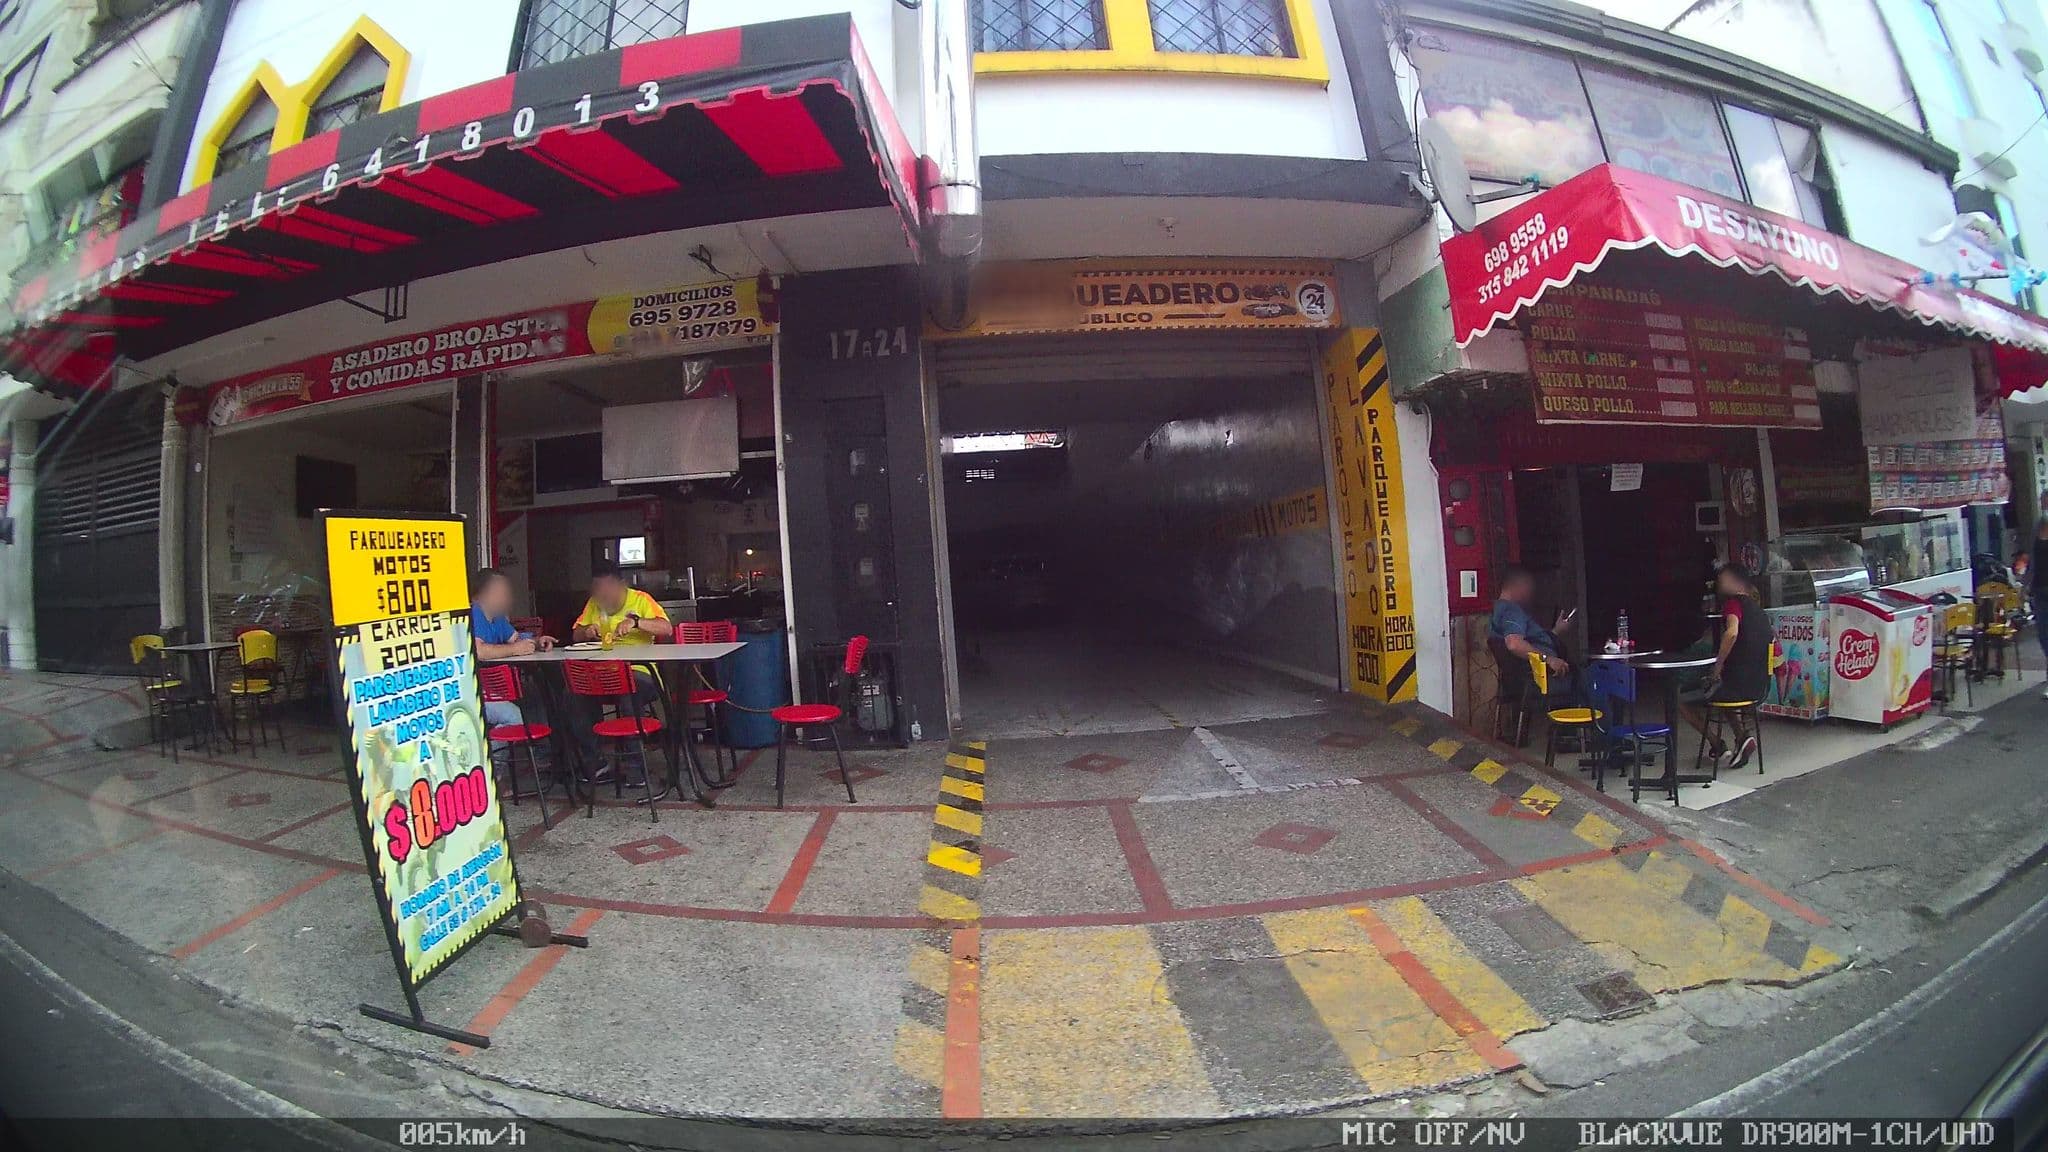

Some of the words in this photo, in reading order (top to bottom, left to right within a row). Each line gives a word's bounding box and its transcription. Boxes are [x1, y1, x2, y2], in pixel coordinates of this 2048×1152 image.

[321, 81, 660, 193] 6418013
[1484, 241, 1509, 273] 698
[1509, 212, 1547, 261] 9558
[1676, 194, 1840, 271] DESAYUNO
[1477, 276, 1502, 304] 315
[1503, 255, 1529, 289] 842
[1530, 225, 1570, 273] 1119
[633, 285, 733, 309] DOMICILIOS
[1306, 293, 1326, 309] 24
[1528, 303, 1574, 319] CARNE
[629, 307, 672, 327] 695
[678, 300, 737, 321] 9728
[1531, 325, 1576, 341] POLLO
[330, 336, 429, 374] ASADERO
[1535, 349, 1579, 365] MIXTA
[330, 377, 342, 394] Y
[346, 355, 446, 391] COMIDAS
[1539, 372, 1583, 388] MIXTA
[1586, 375, 1627, 390] POLLO
[1543, 396, 1590, 412] QUESO
[1593, 398, 1634, 414] POLLO
[1327, 373, 1358, 598] PARQUEO
[1346, 376, 1379, 616] LAVADO
[1367, 408, 1397, 610] PARQUEADERO
[351, 530, 446, 550] PARQUEADERO
[373, 555, 431, 575] MOTOS
[377, 579, 432, 615] $800
[372, 613, 442, 642] CARROS
[1352, 624, 1384, 651] HORA
[1385, 615, 1414, 638] HORA
[1778, 625, 1814, 641] HELADOS
[380, 637, 436, 669] 2000
[1386, 634, 1414, 651] 800
[1842, 634, 1873, 655] Crem
[1357, 652, 1379, 685] 800
[1838, 652, 1876, 672] Helado
[354, 657, 454, 704] PARQUEADERO
[454, 654, 466, 675] Y
[368, 686, 441, 727] LAVADERO
[444, 681, 461, 703] DE
[396, 709, 445, 746] MOTOS
[419, 740, 432, 763] A
[400, 879, 446, 919] HORARIO
